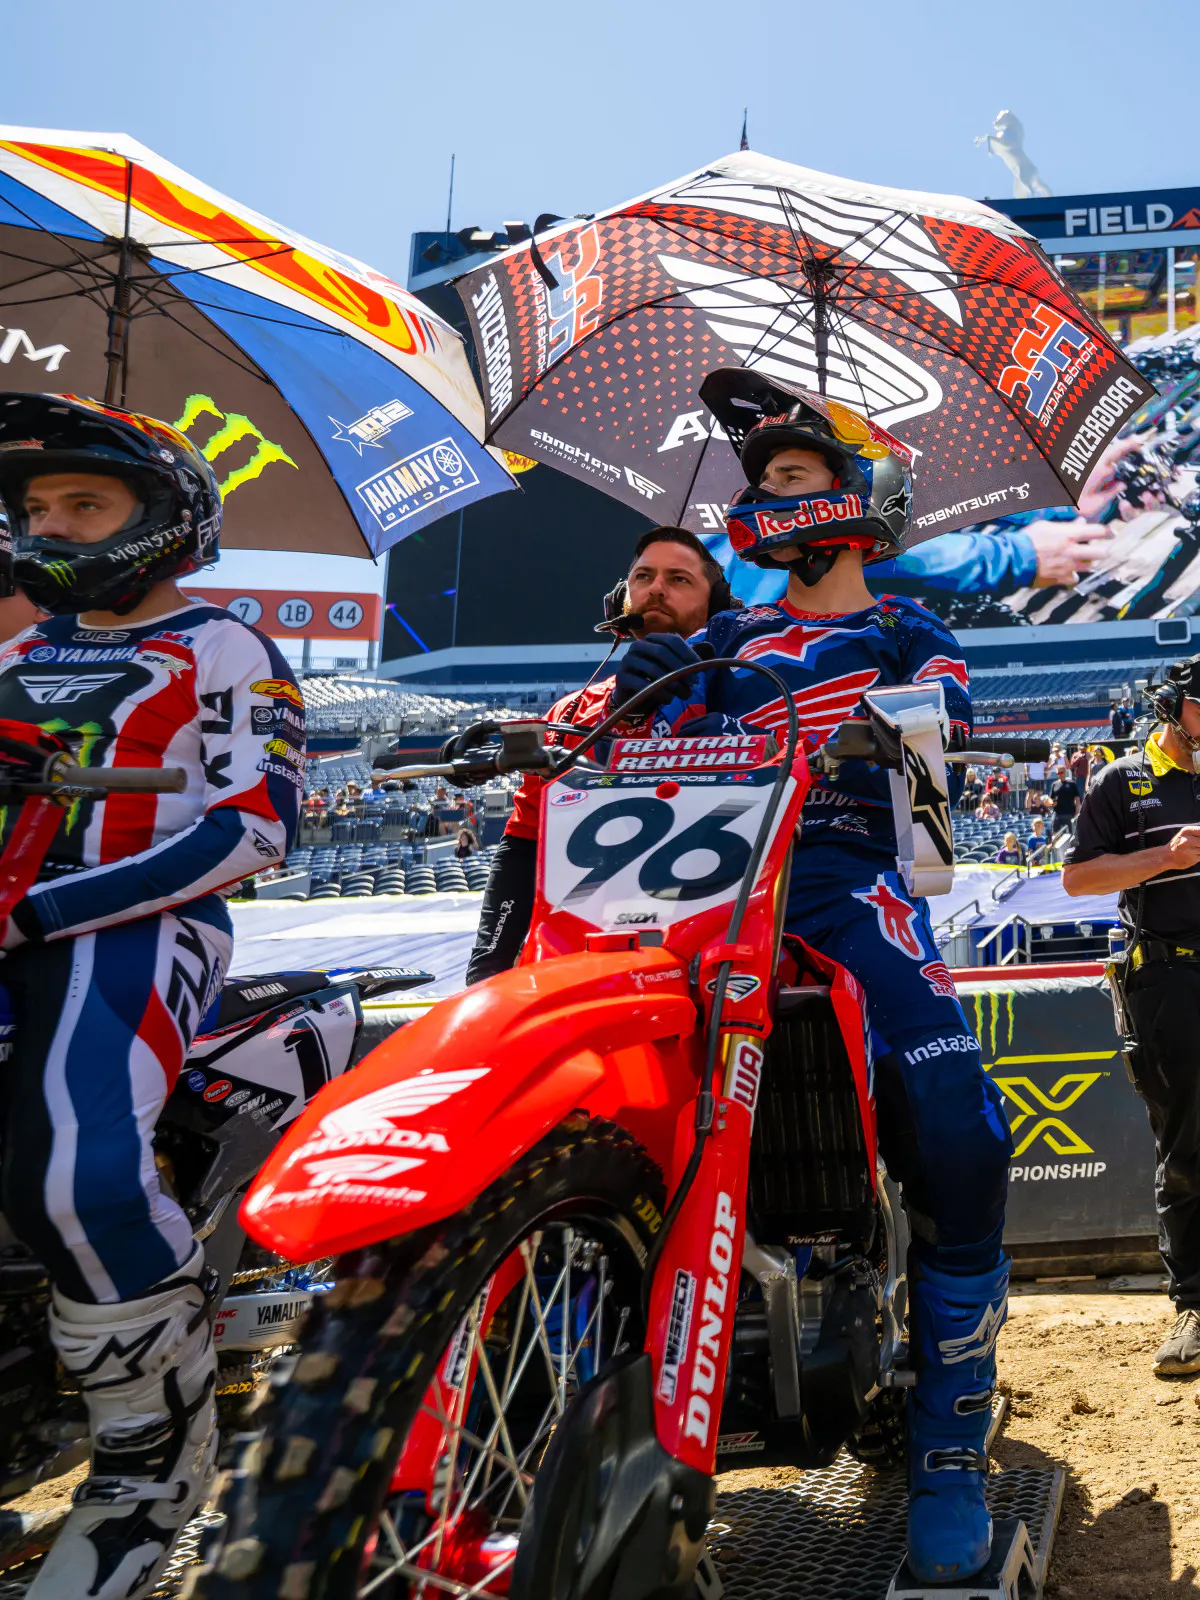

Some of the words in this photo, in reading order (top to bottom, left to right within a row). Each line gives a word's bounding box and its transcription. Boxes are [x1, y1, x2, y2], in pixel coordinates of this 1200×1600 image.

[1065, 203, 1174, 236] FIELD
[755, 500, 813, 538] Red
[814, 494, 865, 526] Bull
[108, 520, 193, 565] MONSTER
[239, 603, 250, 620] 7
[284, 609, 307, 623] 18
[333, 610, 358, 623] 44
[56, 648, 134, 663] YAMAHA
[974, 715, 995, 724] IELD
[621, 735, 758, 752] RENTHAL
[616, 751, 755, 771] RENTHAL
[621, 775, 717, 785] SUPERCROSS
[557, 792, 582, 804] AMA
[552, 795, 758, 914] 96
[614, 911, 659, 925] SKDA
[371, 967, 423, 979] DUNLOP
[239, 982, 289, 1001] YAMAHA
[206, 1085, 220, 1099] Twin
[219, 1083, 231, 1093] Air
[259, 1099, 284, 1116] YAMAHA
[284, 1128, 451, 1168] HONDA
[1008, 1161, 1107, 1183] PIONSHIP
[788, 1235, 813, 1245] Twin
[814, 1233, 837, 1244] Air
[686, 1191, 737, 1448] DUNLOP
